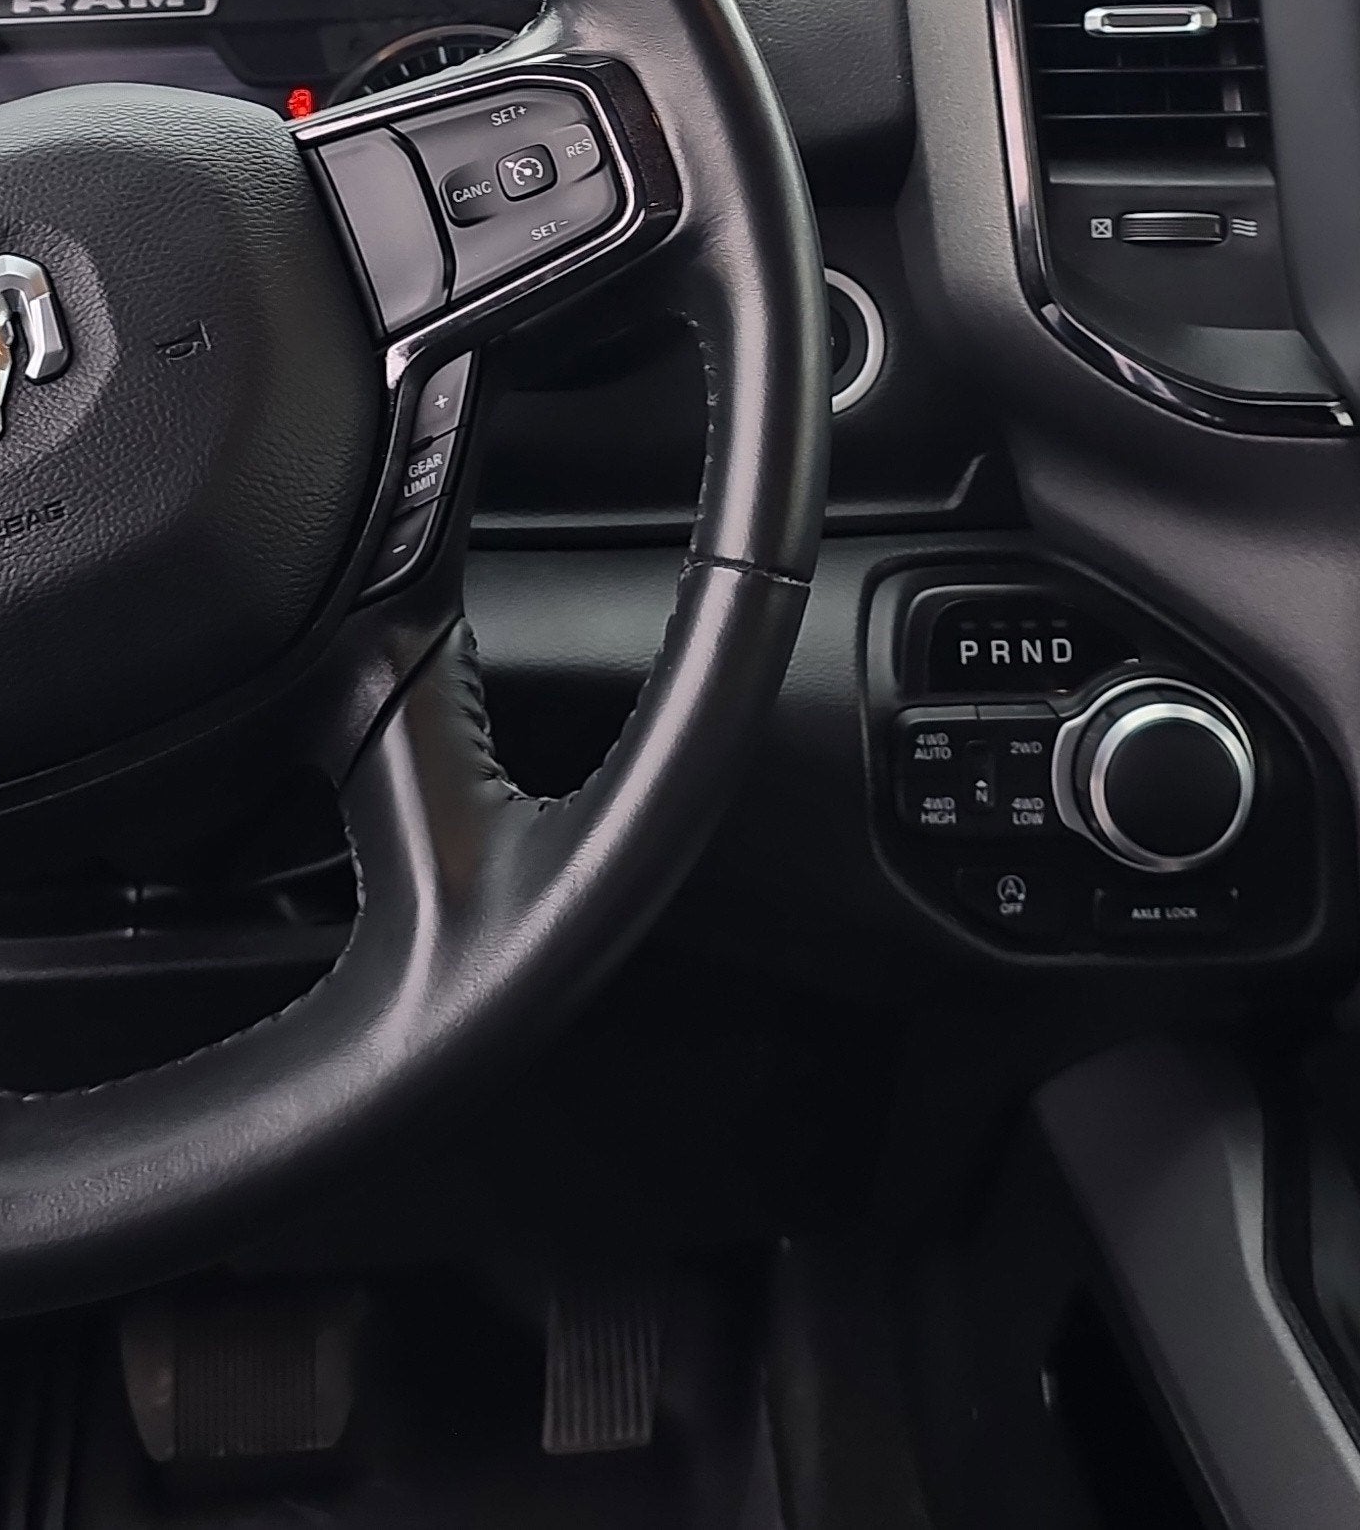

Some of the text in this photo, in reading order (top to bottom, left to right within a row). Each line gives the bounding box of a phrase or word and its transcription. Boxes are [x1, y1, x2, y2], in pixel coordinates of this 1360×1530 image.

[490, 104, 527, 127] SET+
[566, 138, 593, 159] RES
[452, 180, 492, 204] CANC
[408, 453, 443, 478] GEAR
[403, 471, 437, 498] LIMIT
[914, 746, 952, 760] AUTO
[1010, 740, 1043, 754] 2WD
